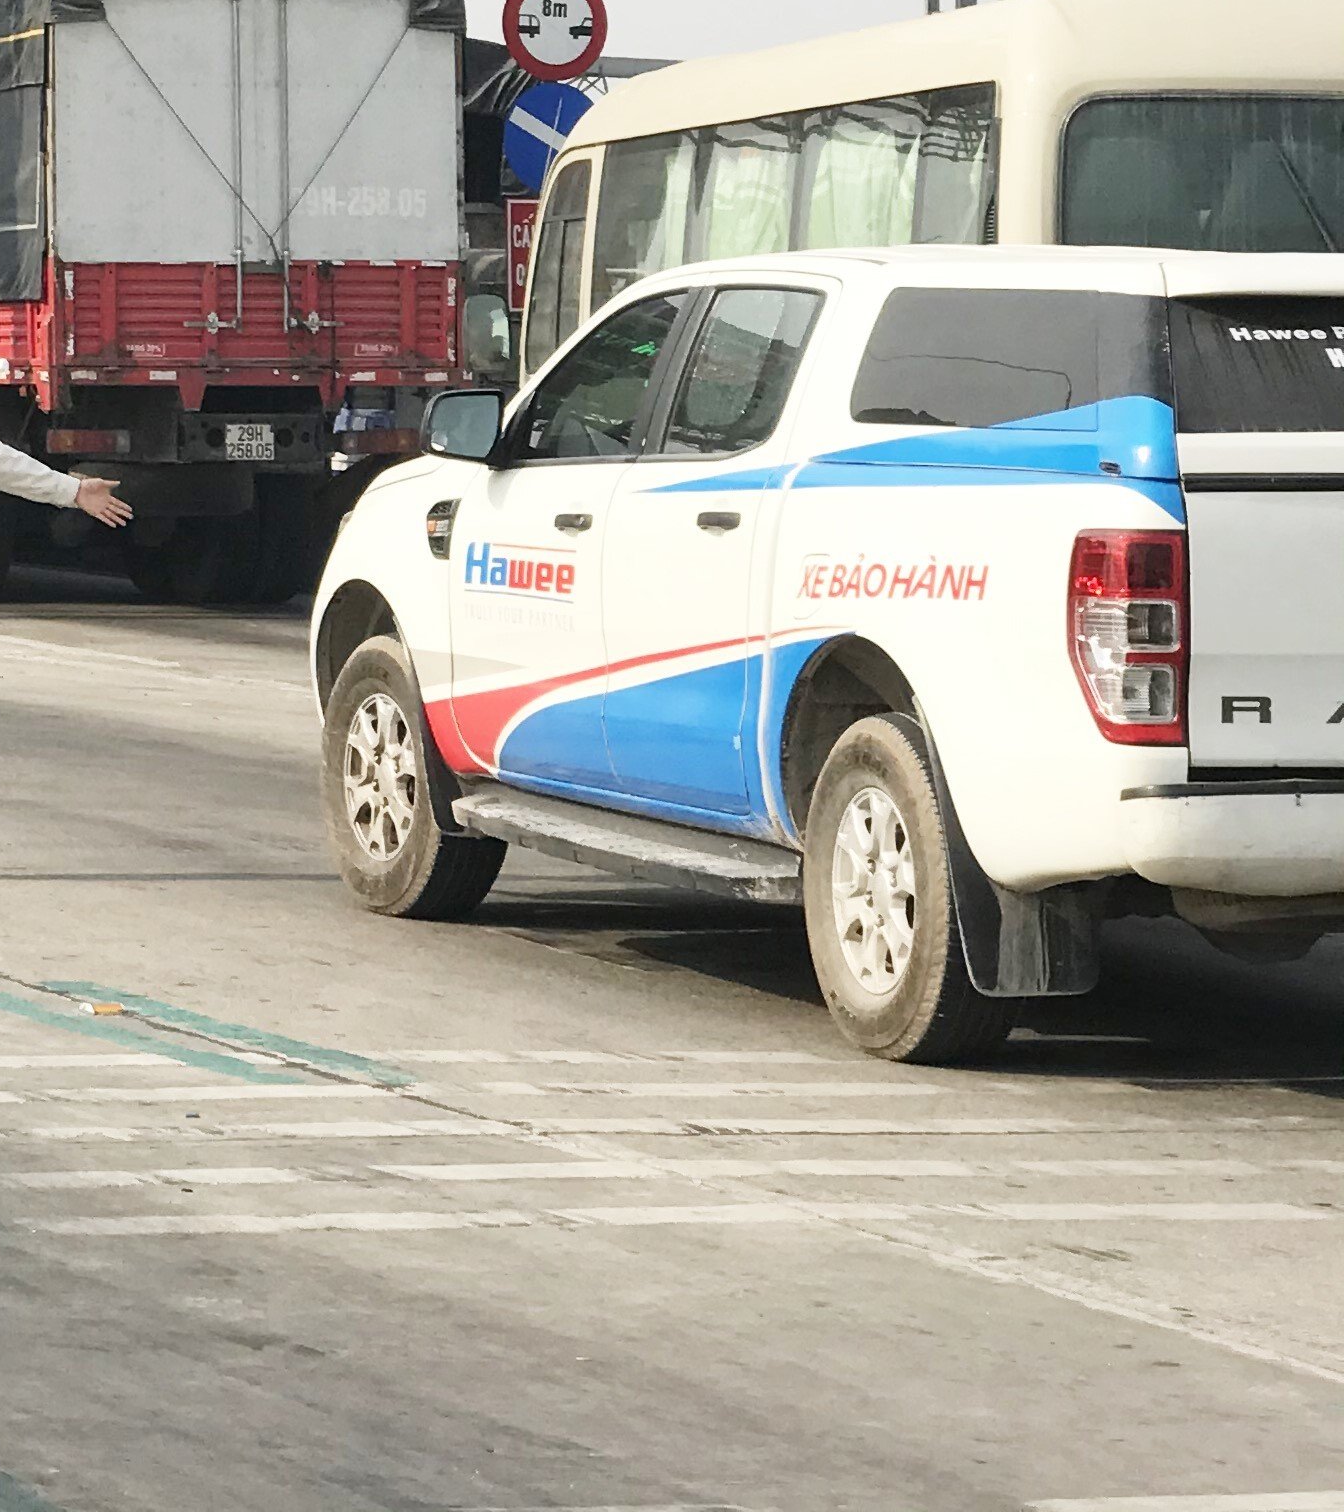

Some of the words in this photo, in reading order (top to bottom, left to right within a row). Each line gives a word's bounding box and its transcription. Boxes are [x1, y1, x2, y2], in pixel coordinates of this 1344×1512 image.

[513, 212, 535, 248] CẤ
[1228, 327, 1328, 342] Hawee
[237, 426, 263, 442] 29H
[228, 443, 274, 459] 258.05
[465, 541, 576, 595] Hawee
[796, 564, 829, 598] XE
[828, 553, 887, 599] BẢO
[887, 555, 990, 601] HÀNH
